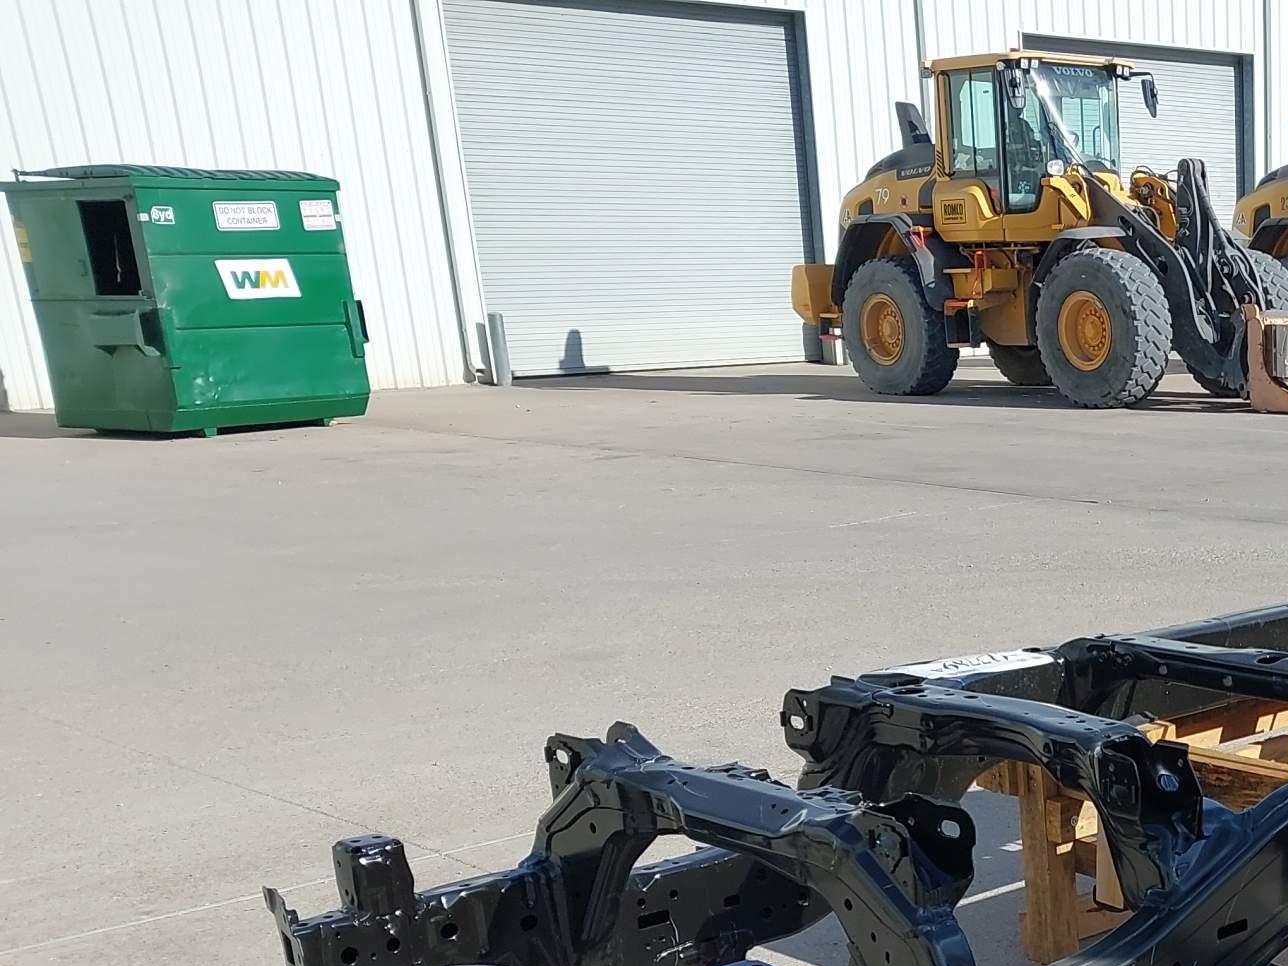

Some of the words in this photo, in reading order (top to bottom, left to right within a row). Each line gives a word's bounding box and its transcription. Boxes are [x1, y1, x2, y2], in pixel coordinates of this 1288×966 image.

[1052, 66, 1093, 77] VOLVO
[901, 166, 931, 177] VOLVO
[875, 188, 890, 205] 79
[230, 206, 245, 214] NOT
[247, 206, 273, 214] BLOCK
[227, 217, 268, 225] CONTAINER
[230, 271, 289, 289] WM
